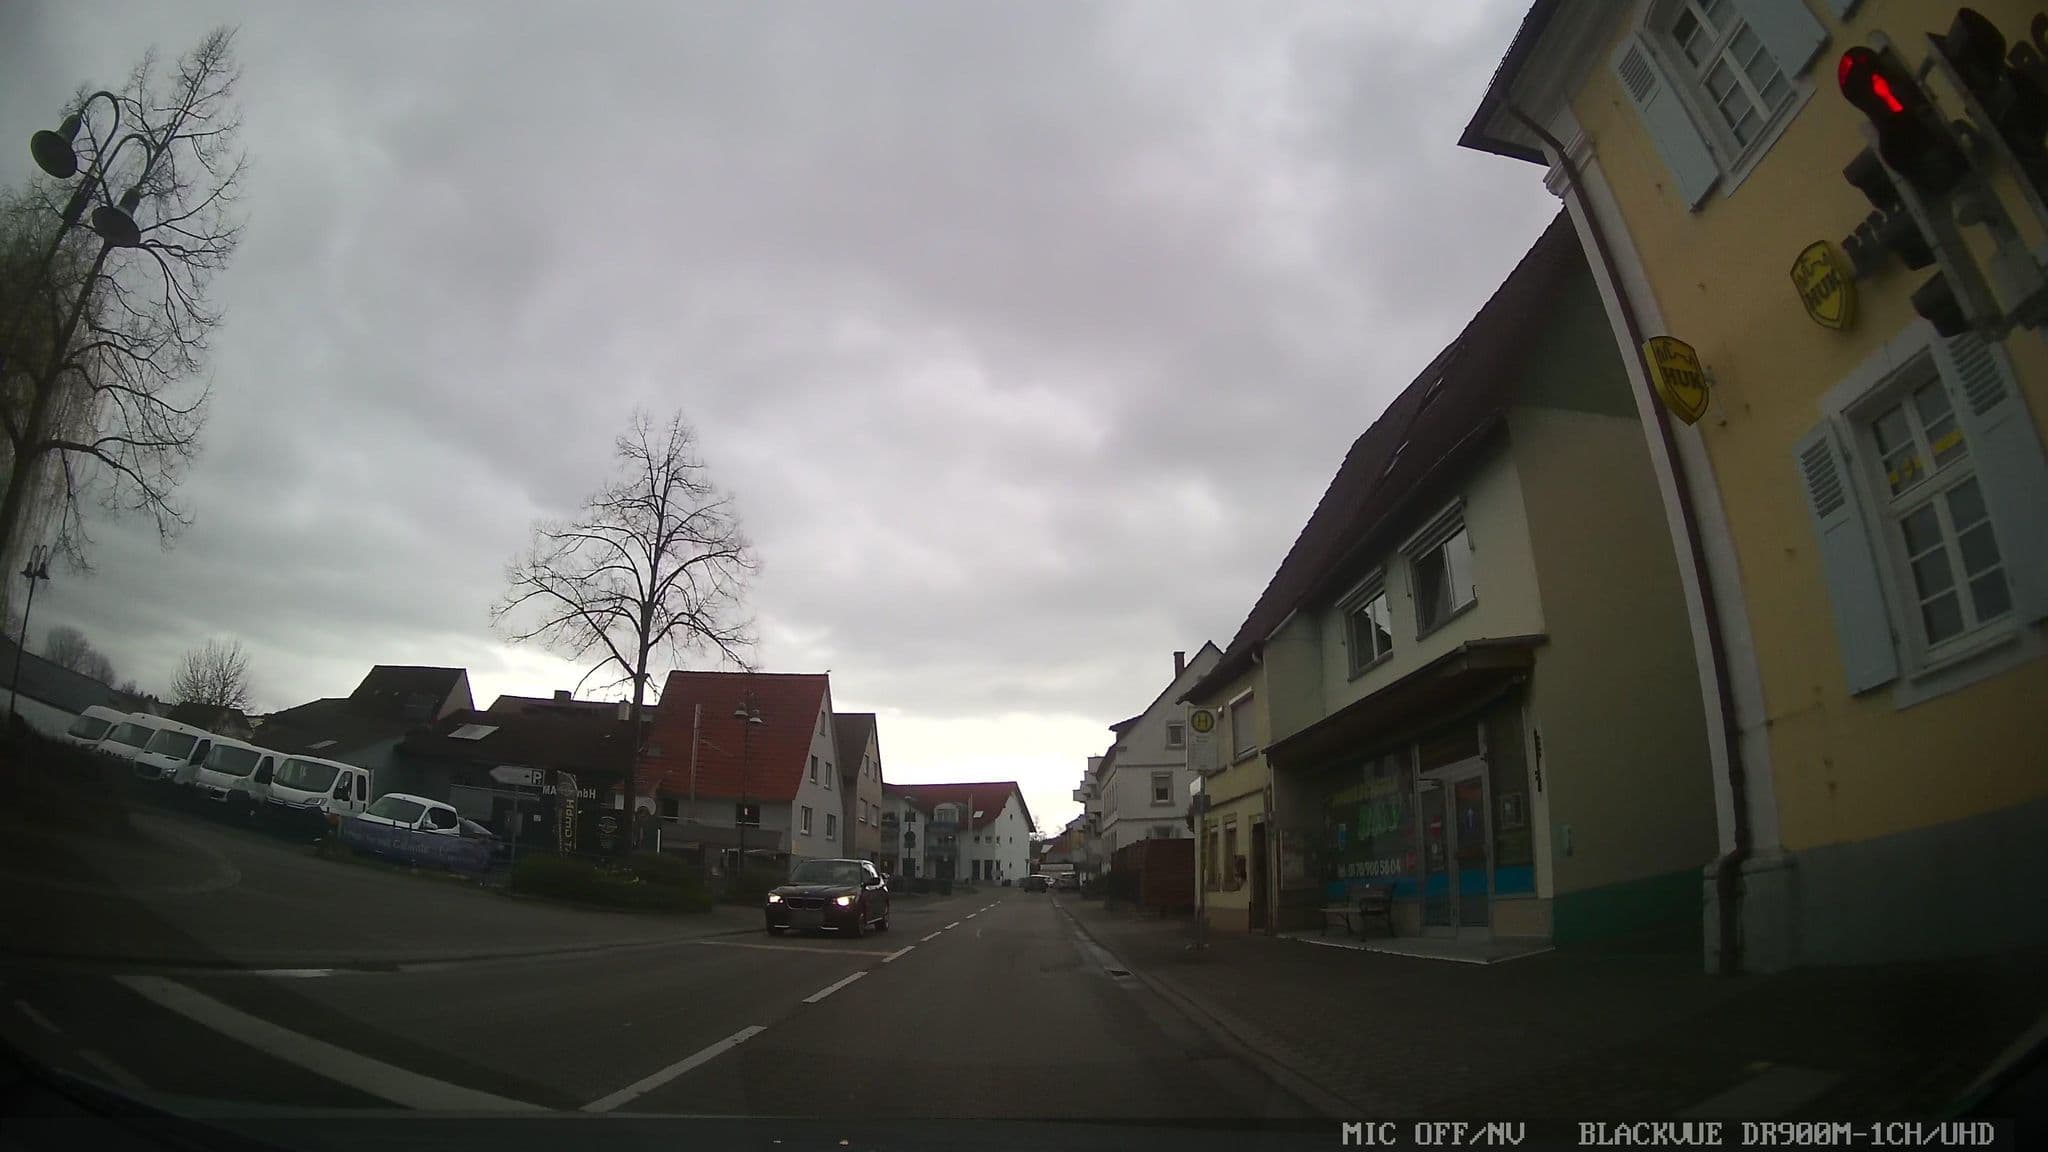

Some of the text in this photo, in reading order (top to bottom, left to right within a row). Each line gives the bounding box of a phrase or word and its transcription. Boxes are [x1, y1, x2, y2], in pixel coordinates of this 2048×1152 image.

[1805, 268, 1840, 310] HUK
[1662, 367, 1704, 390] HUK
[1197, 714, 1209, 729] H
[533, 771, 543, 784] P
